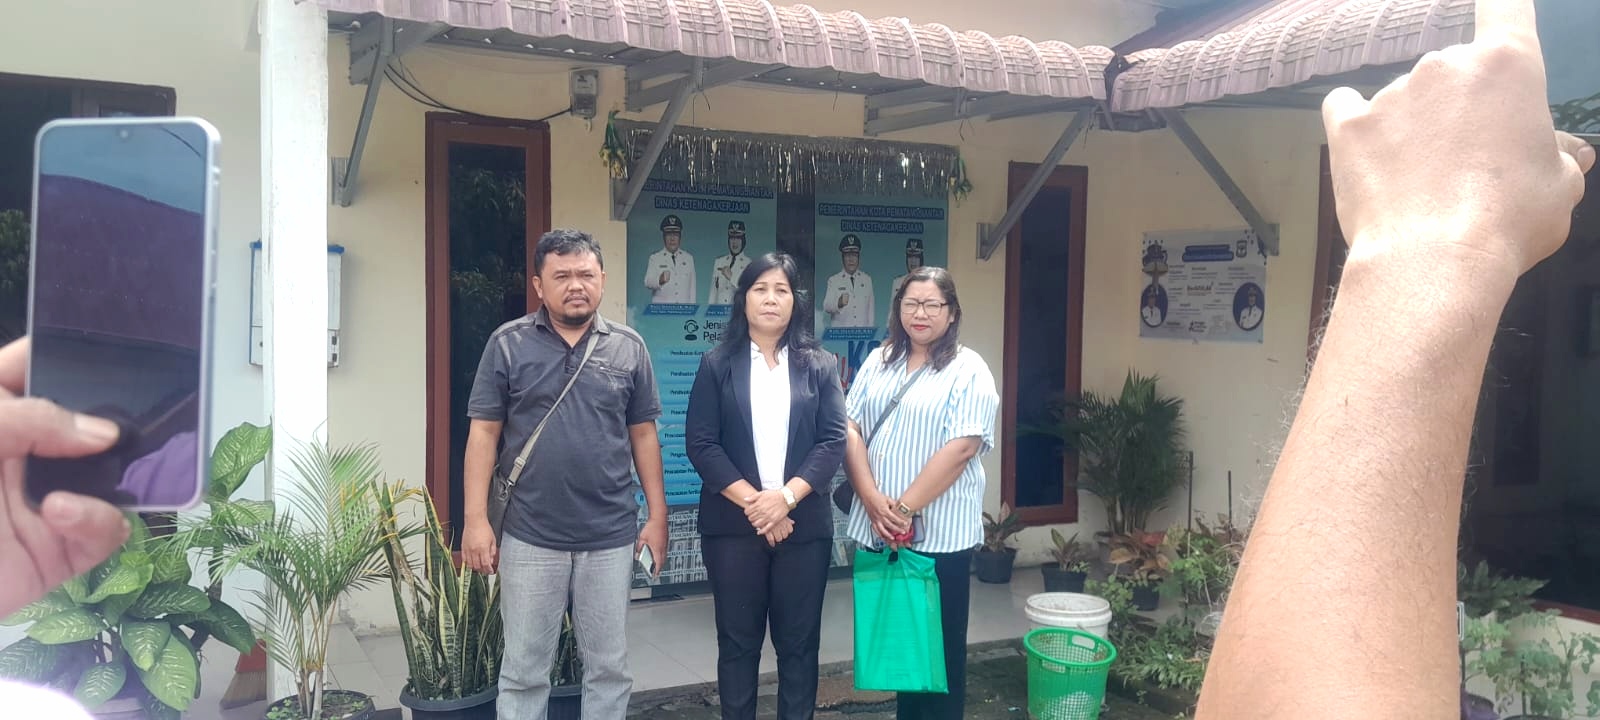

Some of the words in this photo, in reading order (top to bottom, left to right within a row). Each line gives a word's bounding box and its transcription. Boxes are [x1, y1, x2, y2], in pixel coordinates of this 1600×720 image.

[655, 197, 677, 209] DINAS
[679, 198, 750, 213] KETENAGAKERJAAN
[703, 332, 722, 341] Pela
